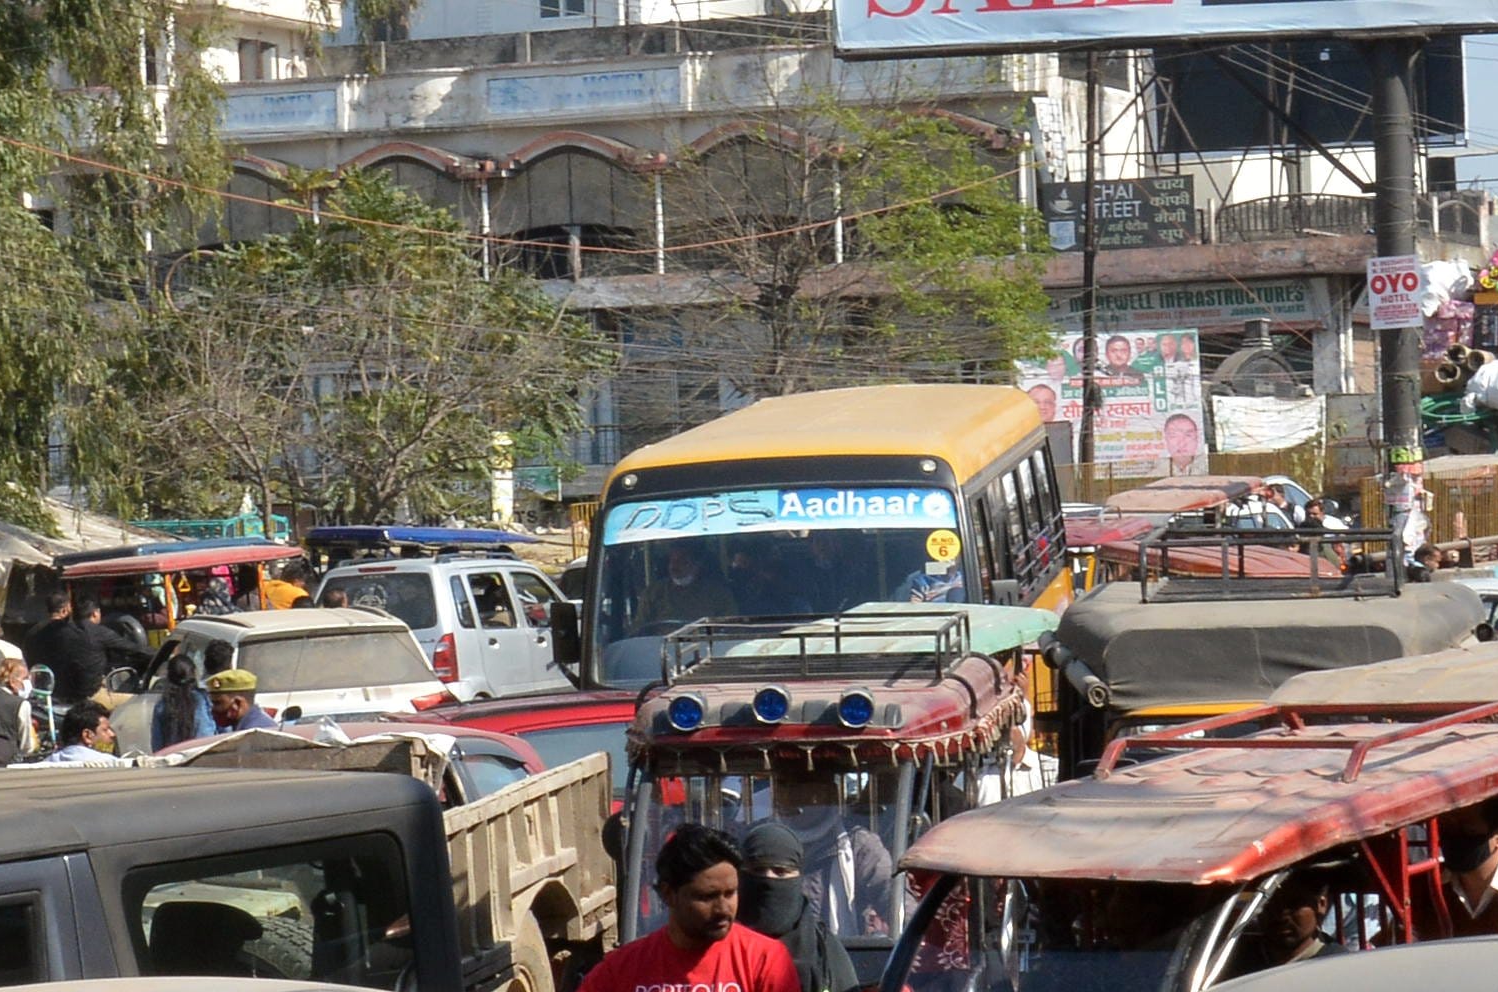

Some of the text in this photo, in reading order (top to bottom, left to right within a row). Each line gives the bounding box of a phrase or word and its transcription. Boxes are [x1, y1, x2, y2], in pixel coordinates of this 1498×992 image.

[1370, 272, 1419, 295] OYO
[1159, 284, 1304, 309] INFRASTRUCTURES
[1381, 294, 1411, 304] HOTEL
[781, 490, 919, 518] Aadhaar
[939, 546, 949, 557] 6
